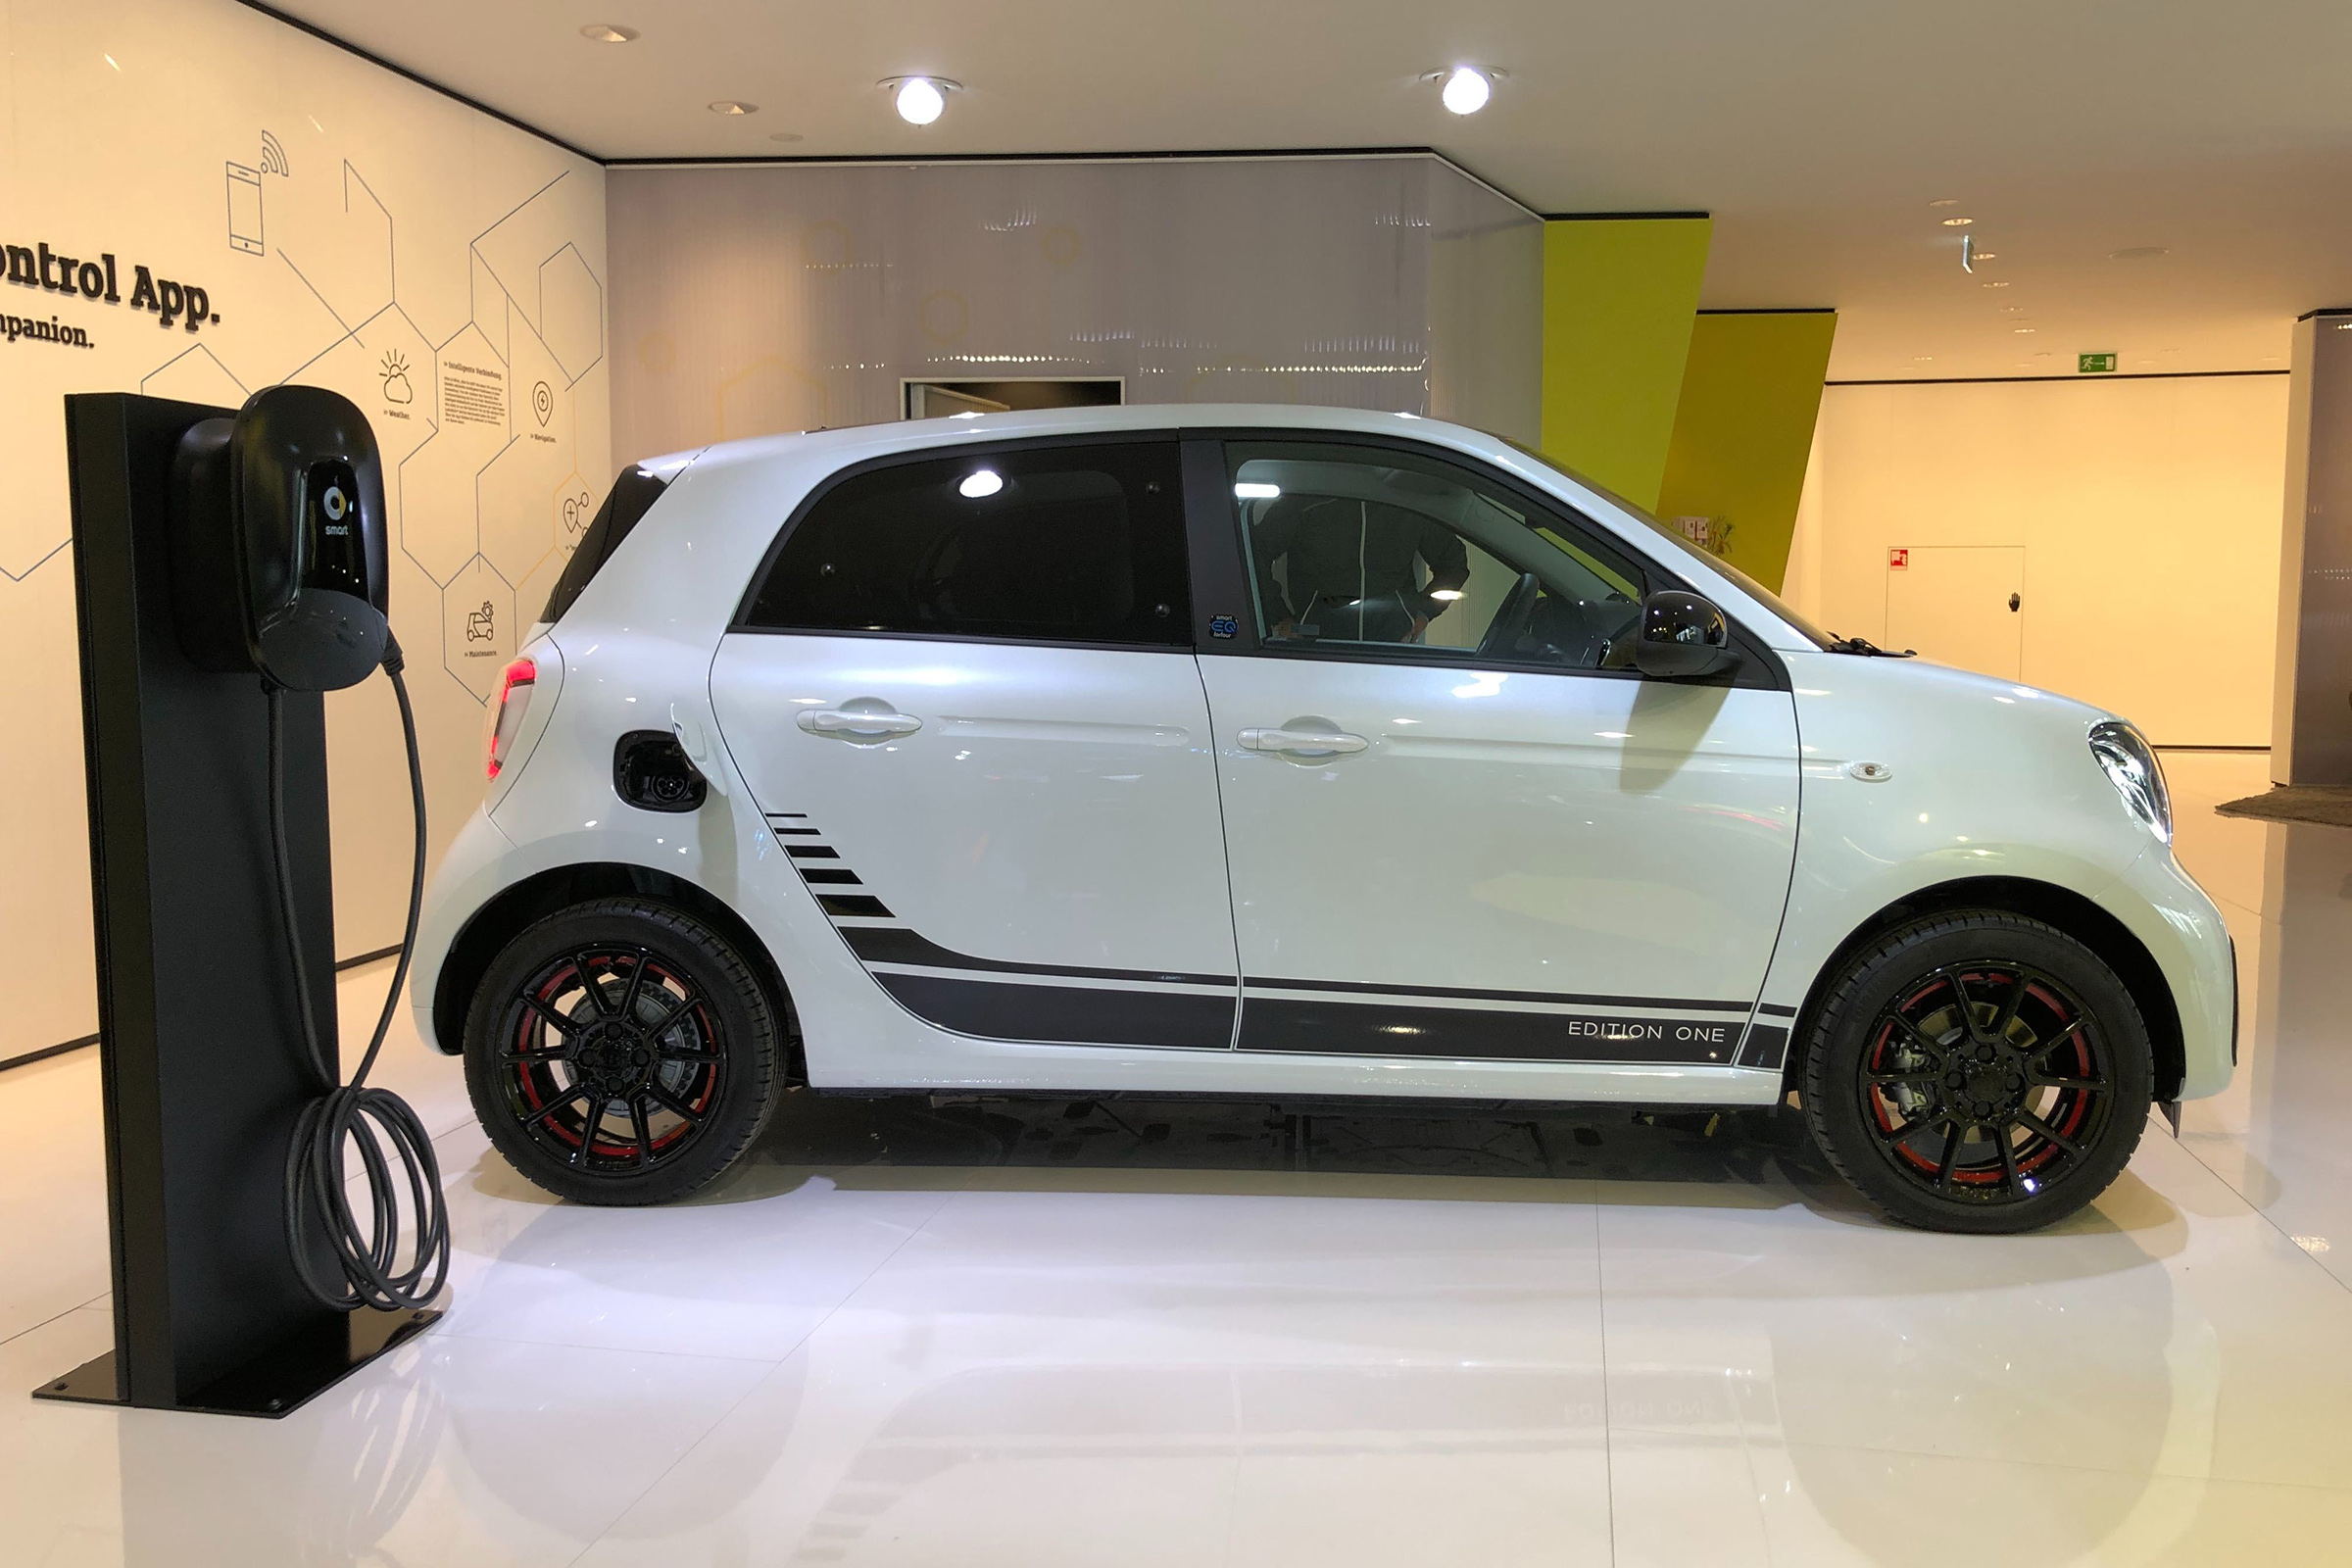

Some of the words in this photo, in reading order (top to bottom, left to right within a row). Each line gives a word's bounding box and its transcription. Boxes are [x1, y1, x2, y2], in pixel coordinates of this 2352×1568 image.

[0, 242, 121, 302] ntrol
[130, 265, 220, 331] App.
[0, 313, 94, 348] panion.
[325, 525, 349, 536] smart
[1211, 620, 1236, 632] EQ
[1568, 1021, 1662, 1039] EDITION
[1675, 1026, 1725, 1042] ONE
